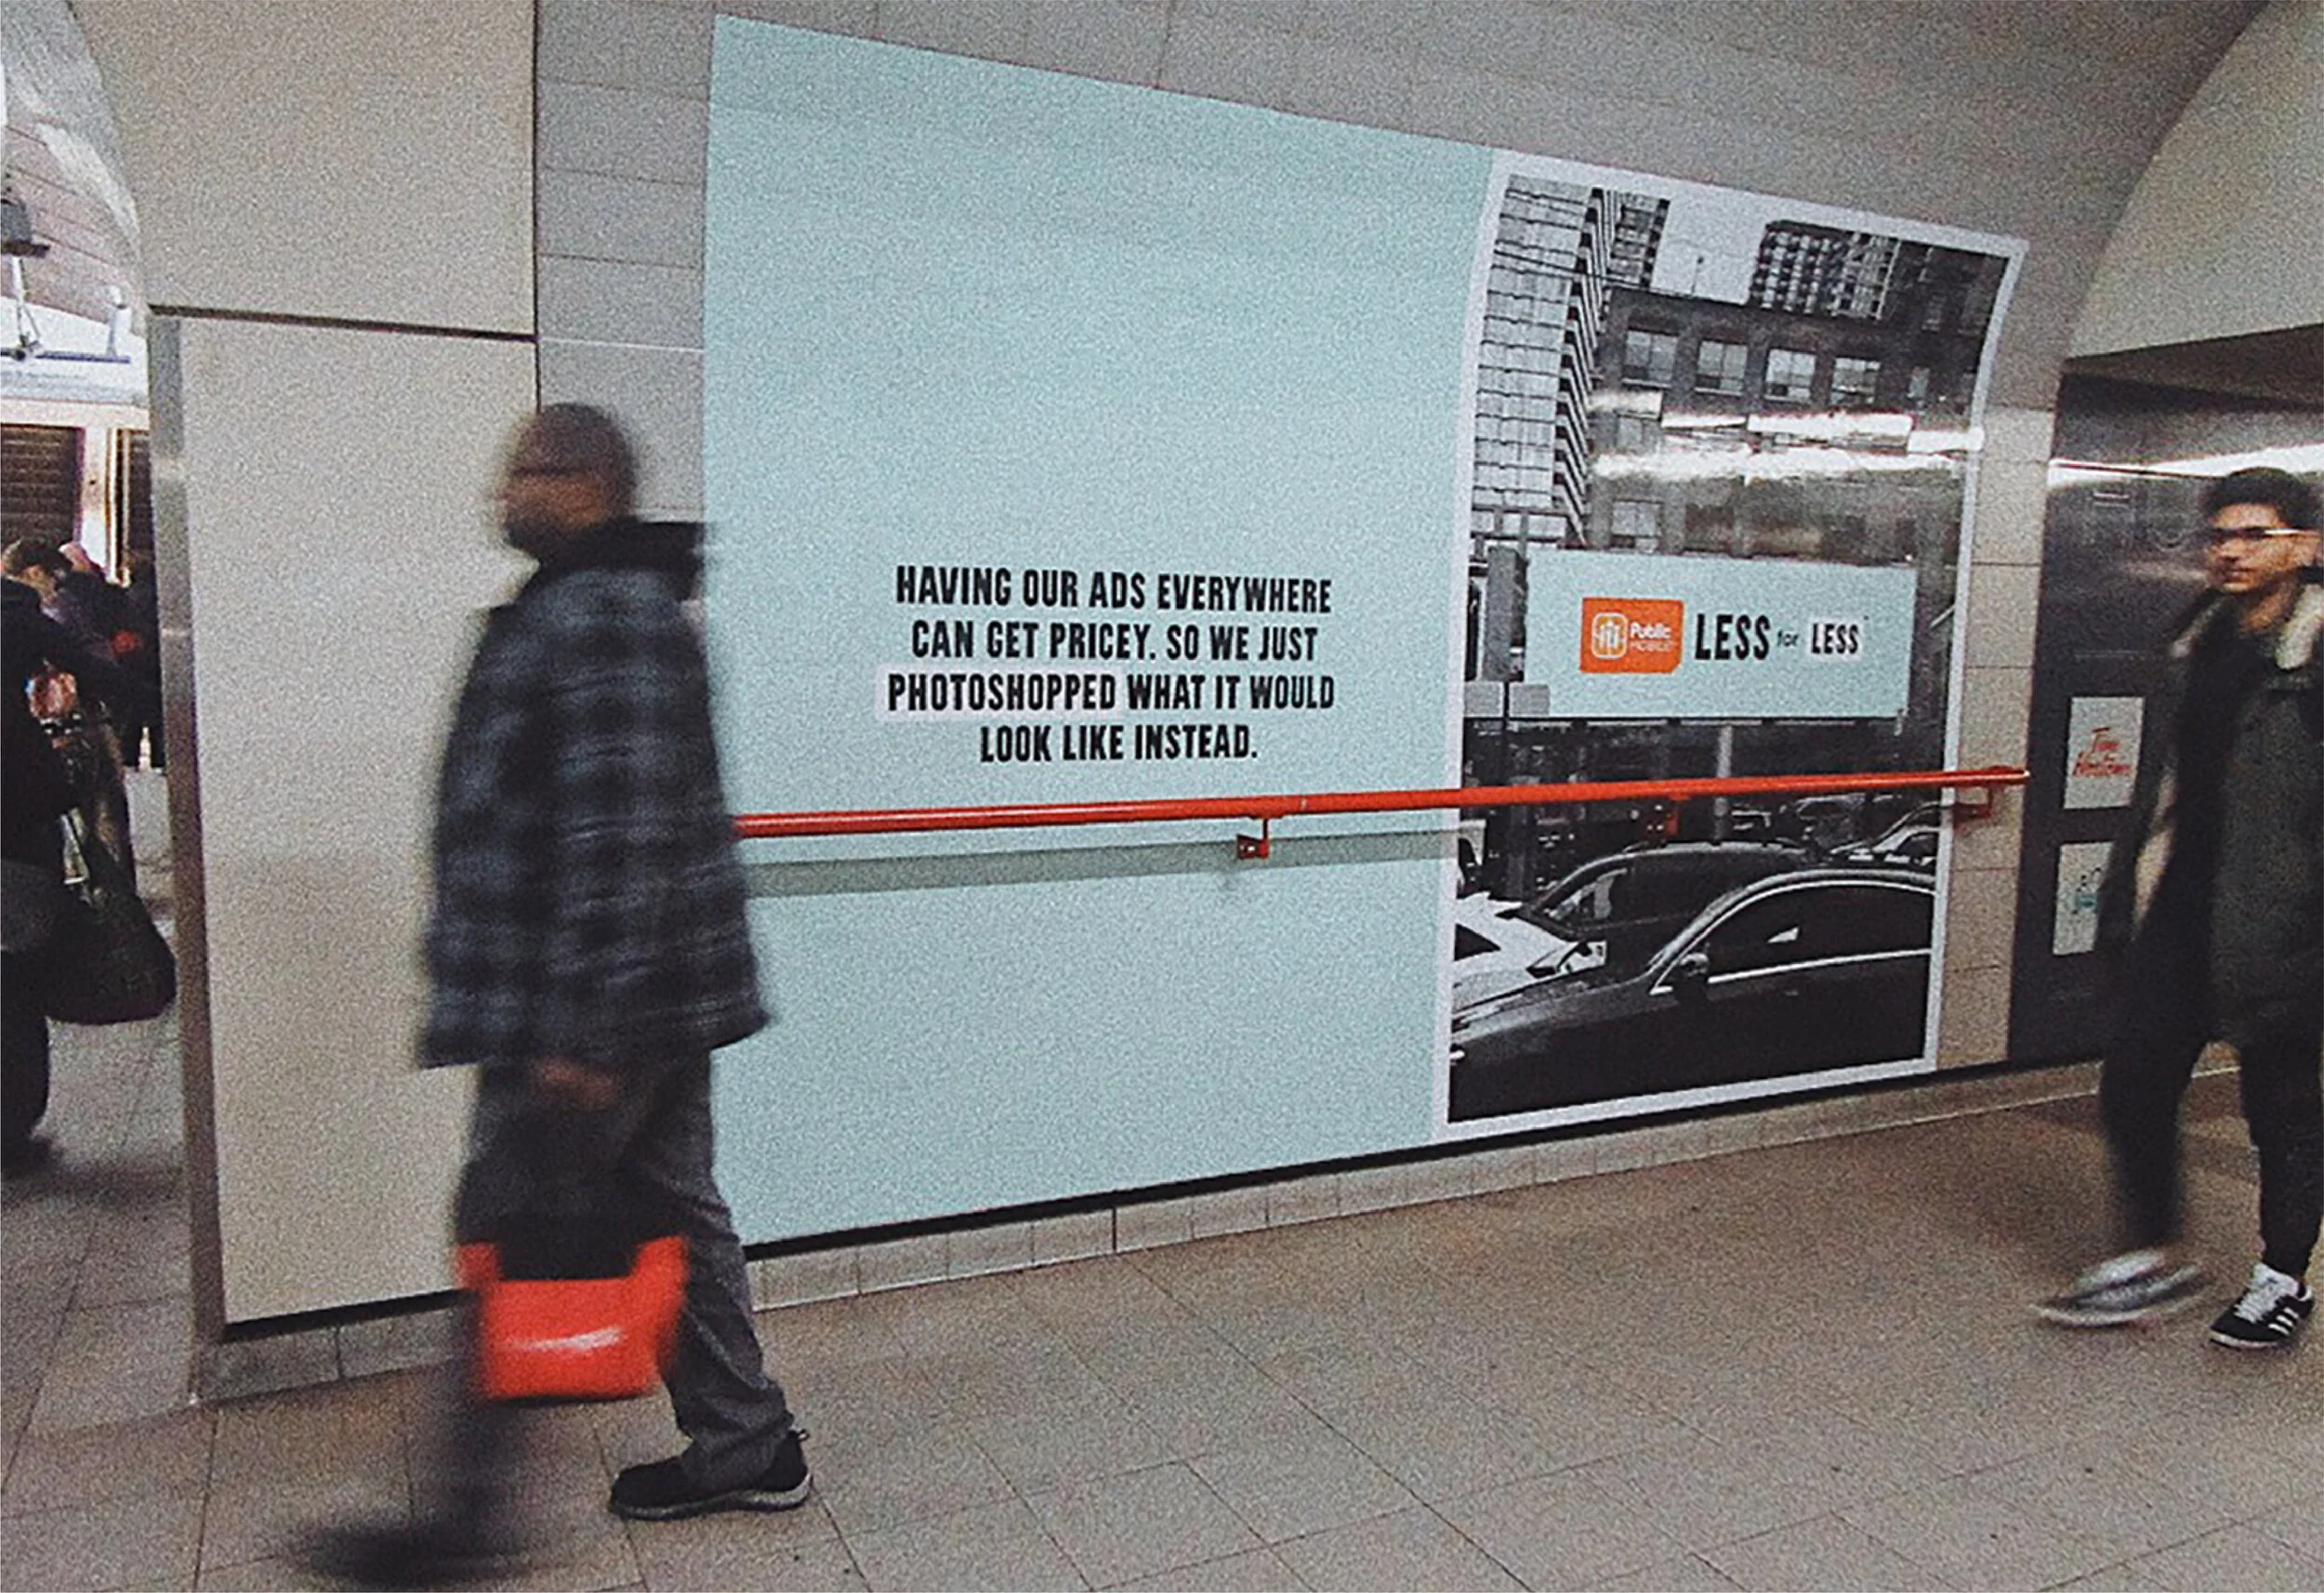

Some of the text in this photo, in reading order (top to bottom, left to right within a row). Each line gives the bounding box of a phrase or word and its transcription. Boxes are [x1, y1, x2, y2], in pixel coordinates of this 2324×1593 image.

[897, 565, 1331, 613] HAVING OUR ADS EVERYWHERE
[913, 620, 1317, 661] CAN GET PRICEY. SO WE JUST
[1630, 621, 1671, 639] Public
[1695, 613, 1858, 660] LESS for LESS
[889, 674, 1334, 711] PHOTOSHOPPED WHAT IT WOULD
[981, 724, 1257, 762] LOOK LIKE INSTEAD.
